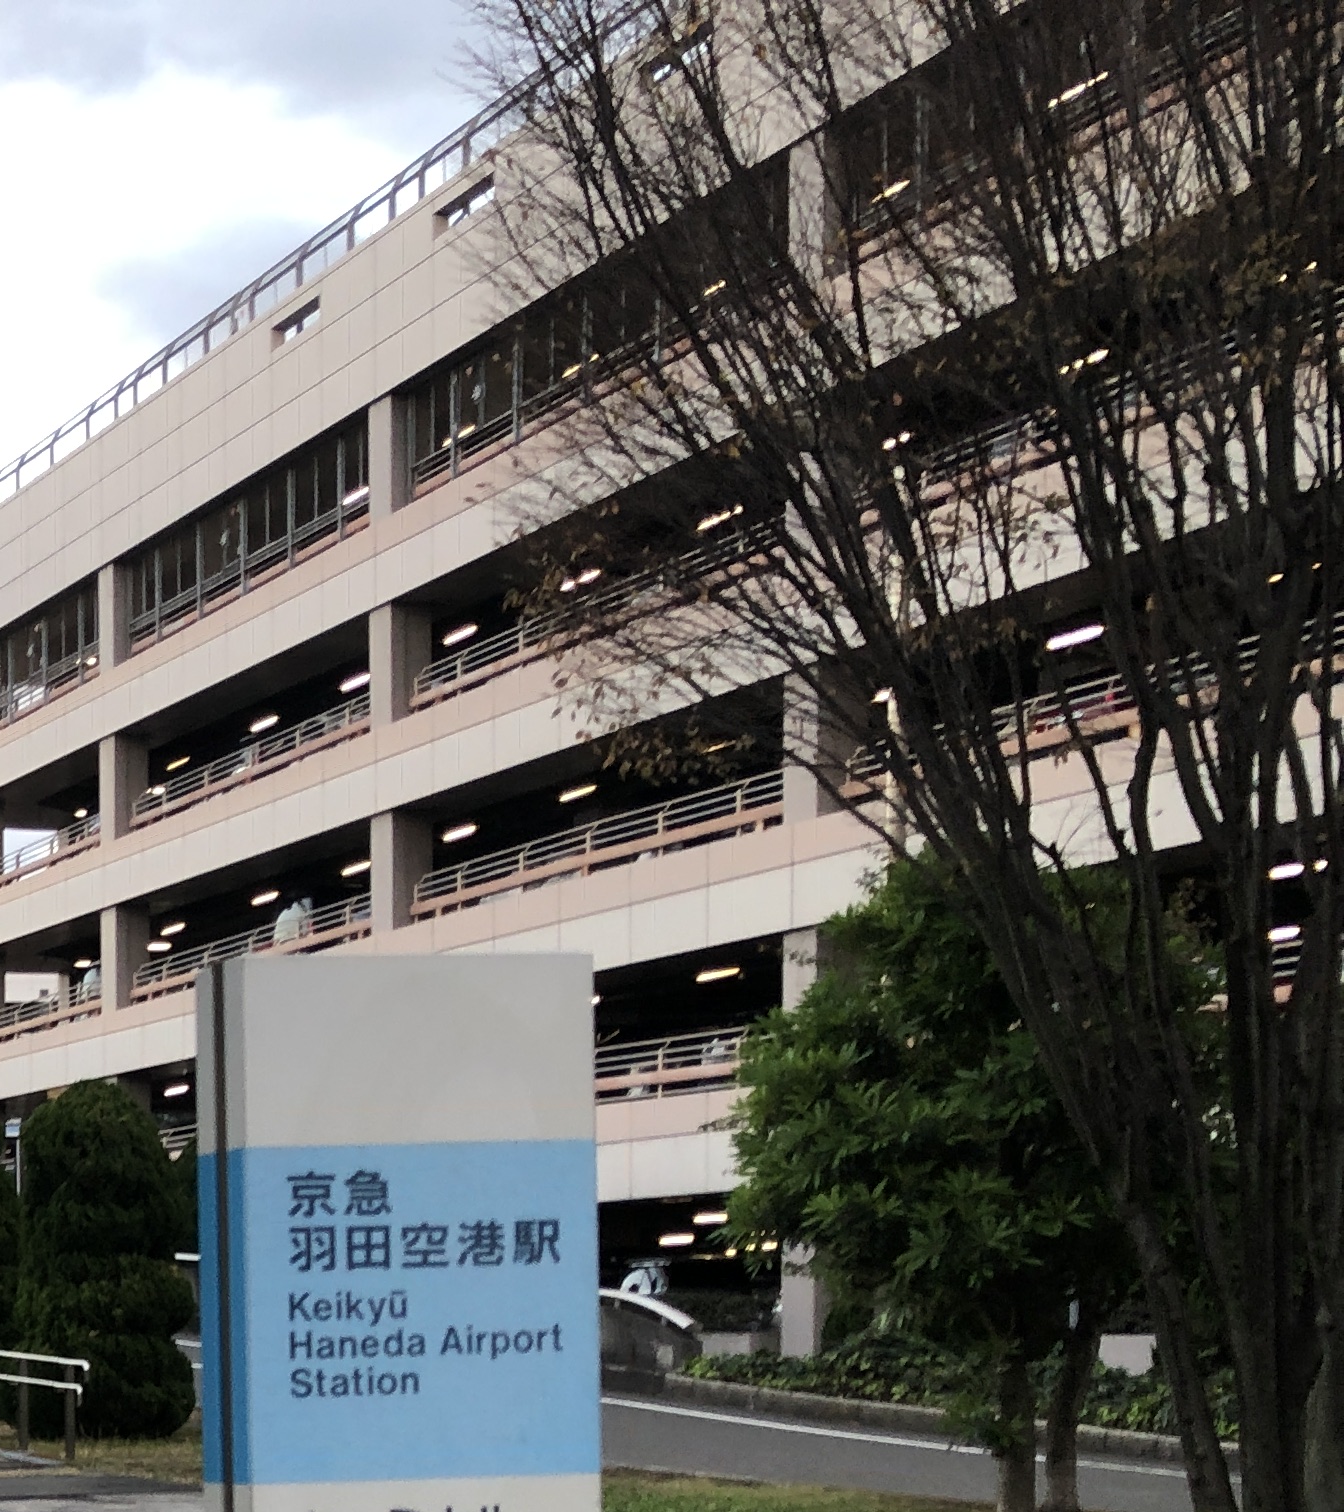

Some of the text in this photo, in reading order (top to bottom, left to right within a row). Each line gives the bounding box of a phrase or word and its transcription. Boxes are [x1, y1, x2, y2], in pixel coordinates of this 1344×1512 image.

[286, 1168, 393, 1219] 京急
[287, 1218, 562, 1273] 羽田空港駅
[288, 1289, 408, 1327] Keikyū
[289, 1322, 563, 1361] Haneda Airport
[289, 1367, 420, 1400] Station
